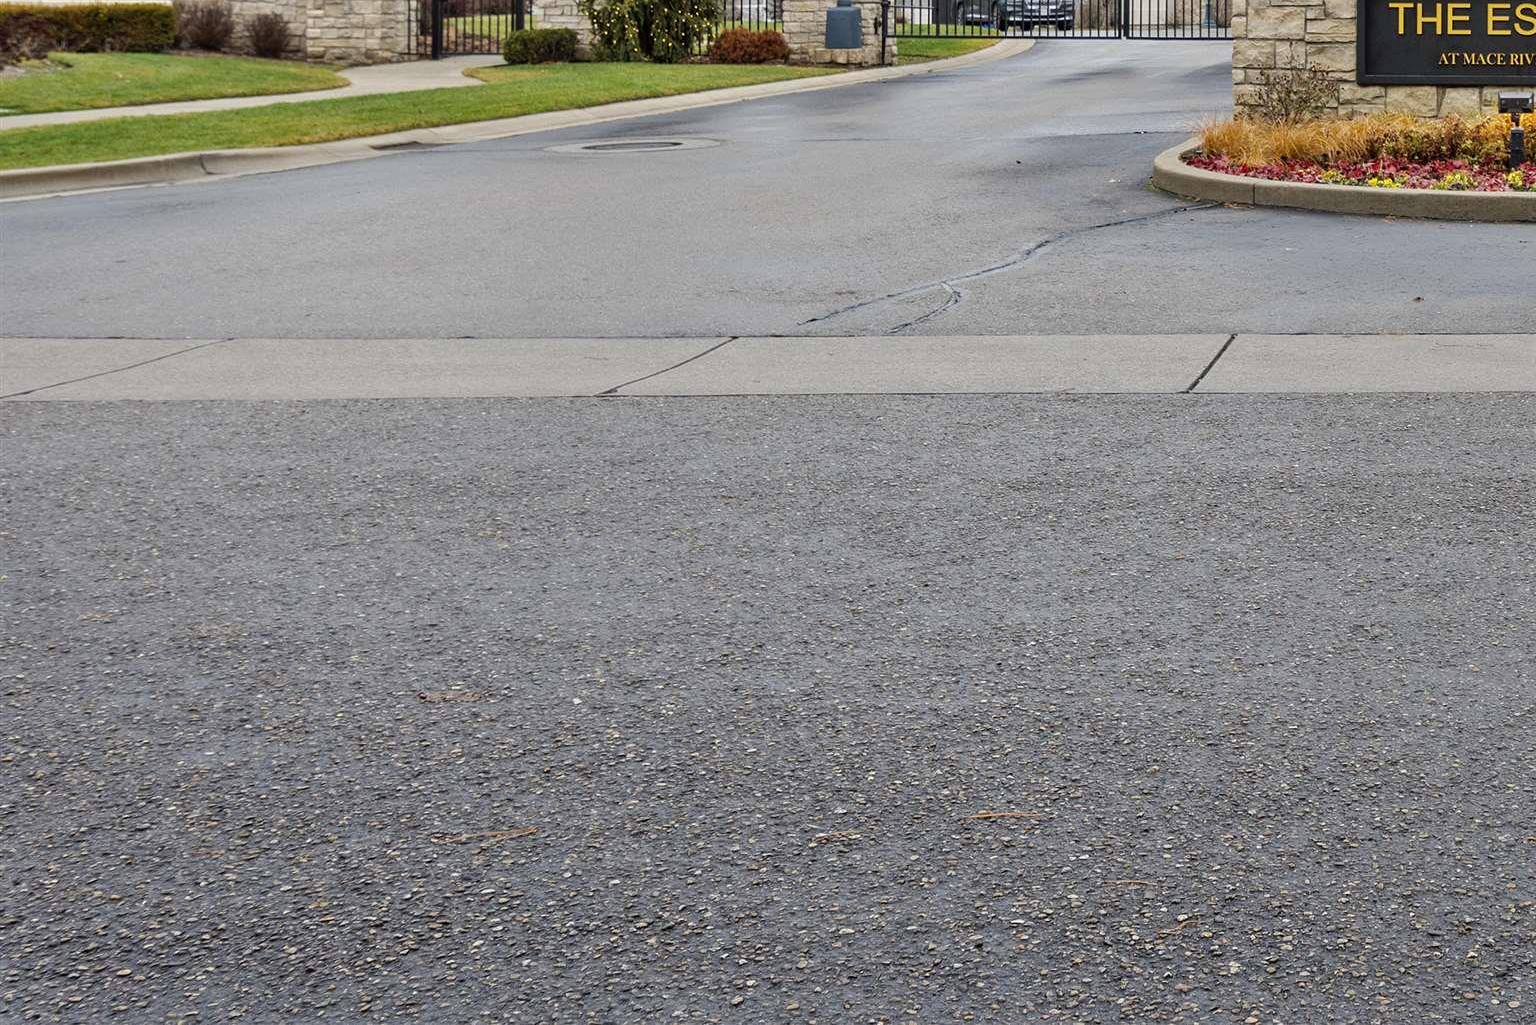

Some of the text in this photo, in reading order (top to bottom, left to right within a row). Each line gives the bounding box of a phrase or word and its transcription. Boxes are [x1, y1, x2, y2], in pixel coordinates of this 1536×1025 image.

[1388, 2, 1472, 35] THE
[1438, 52, 1460, 66] AT
[1463, 52, 1507, 66] MACE
